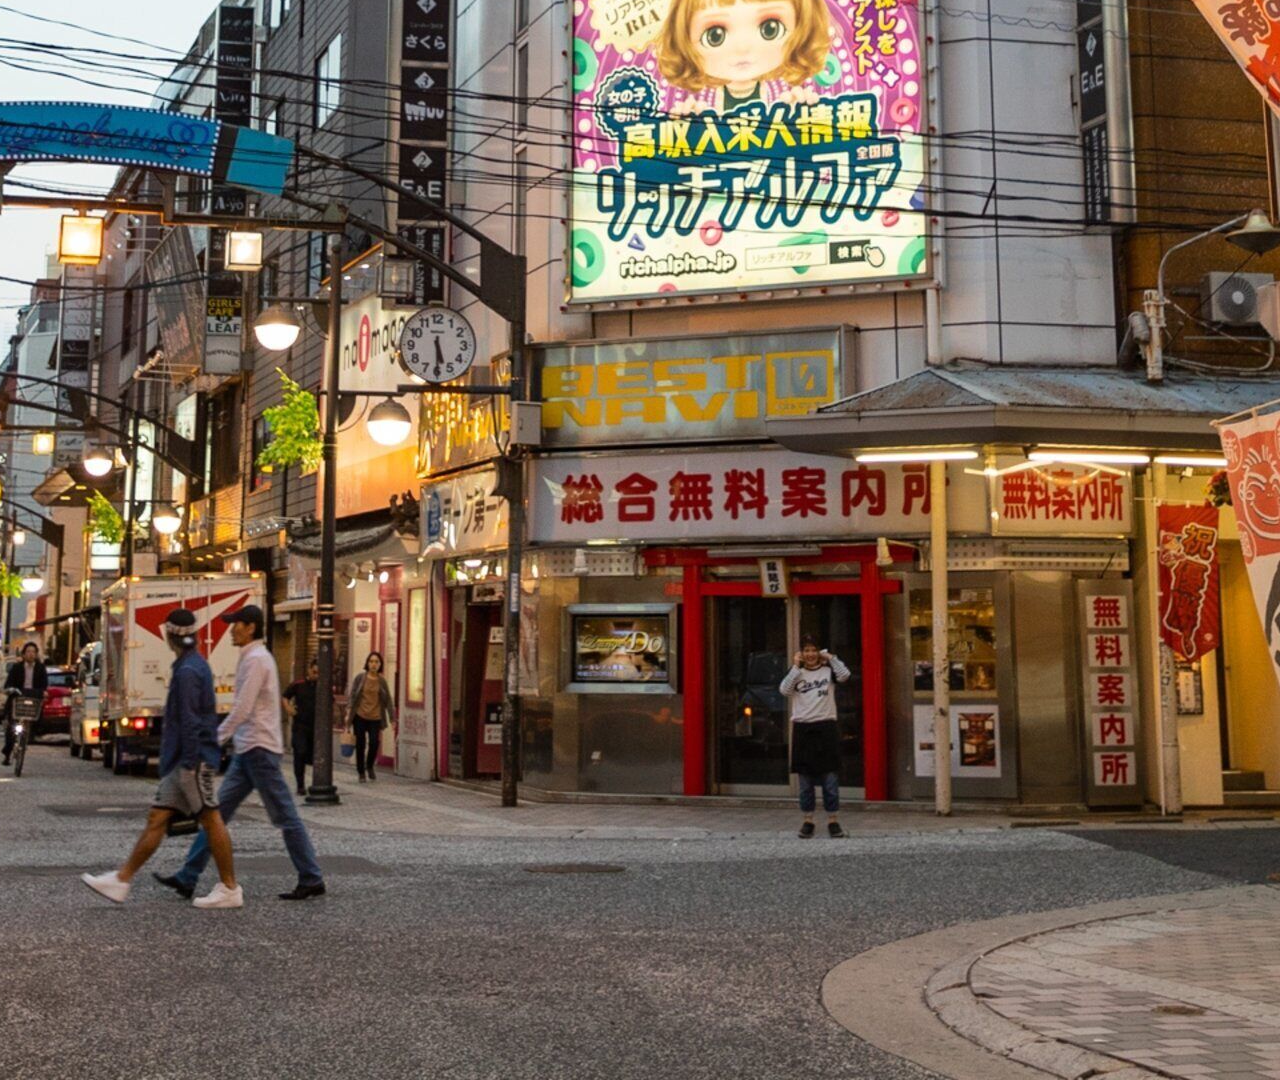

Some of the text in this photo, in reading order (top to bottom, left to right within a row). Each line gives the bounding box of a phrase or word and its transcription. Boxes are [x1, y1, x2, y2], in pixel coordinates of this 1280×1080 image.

[405, 34, 446, 51] さくら
[623, 101, 873, 162] 高収入求人情報
[856, 143, 895, 160] 全国版
[598, 150, 898, 238] リッチアルファ
[620, 249, 737, 278] richalpha.jp
[208, 298, 241, 308] GIRLS
[420, 318, 430, 328] 11
[431, 313, 444, 325] 12
[448, 319, 454, 328] 1
[207, 322, 240, 333] LEAF
[411, 328, 423, 338] 10
[456, 327, 465, 338] 2
[407, 340, 415, 350] 9
[459, 340, 468, 351] 3
[411, 353, 420, 364] 8
[455, 353, 463, 364] 4
[422, 362, 430, 372] 7
[446, 362, 454, 373] 5
[542, 355, 761, 399] BEST
[542, 390, 759, 429] NAVI
[561, 462, 949, 525] 総合無料案内所
[1002, 467, 1124, 521] 無料案内所
[1093, 596, 1129, 786] 無料案内所
